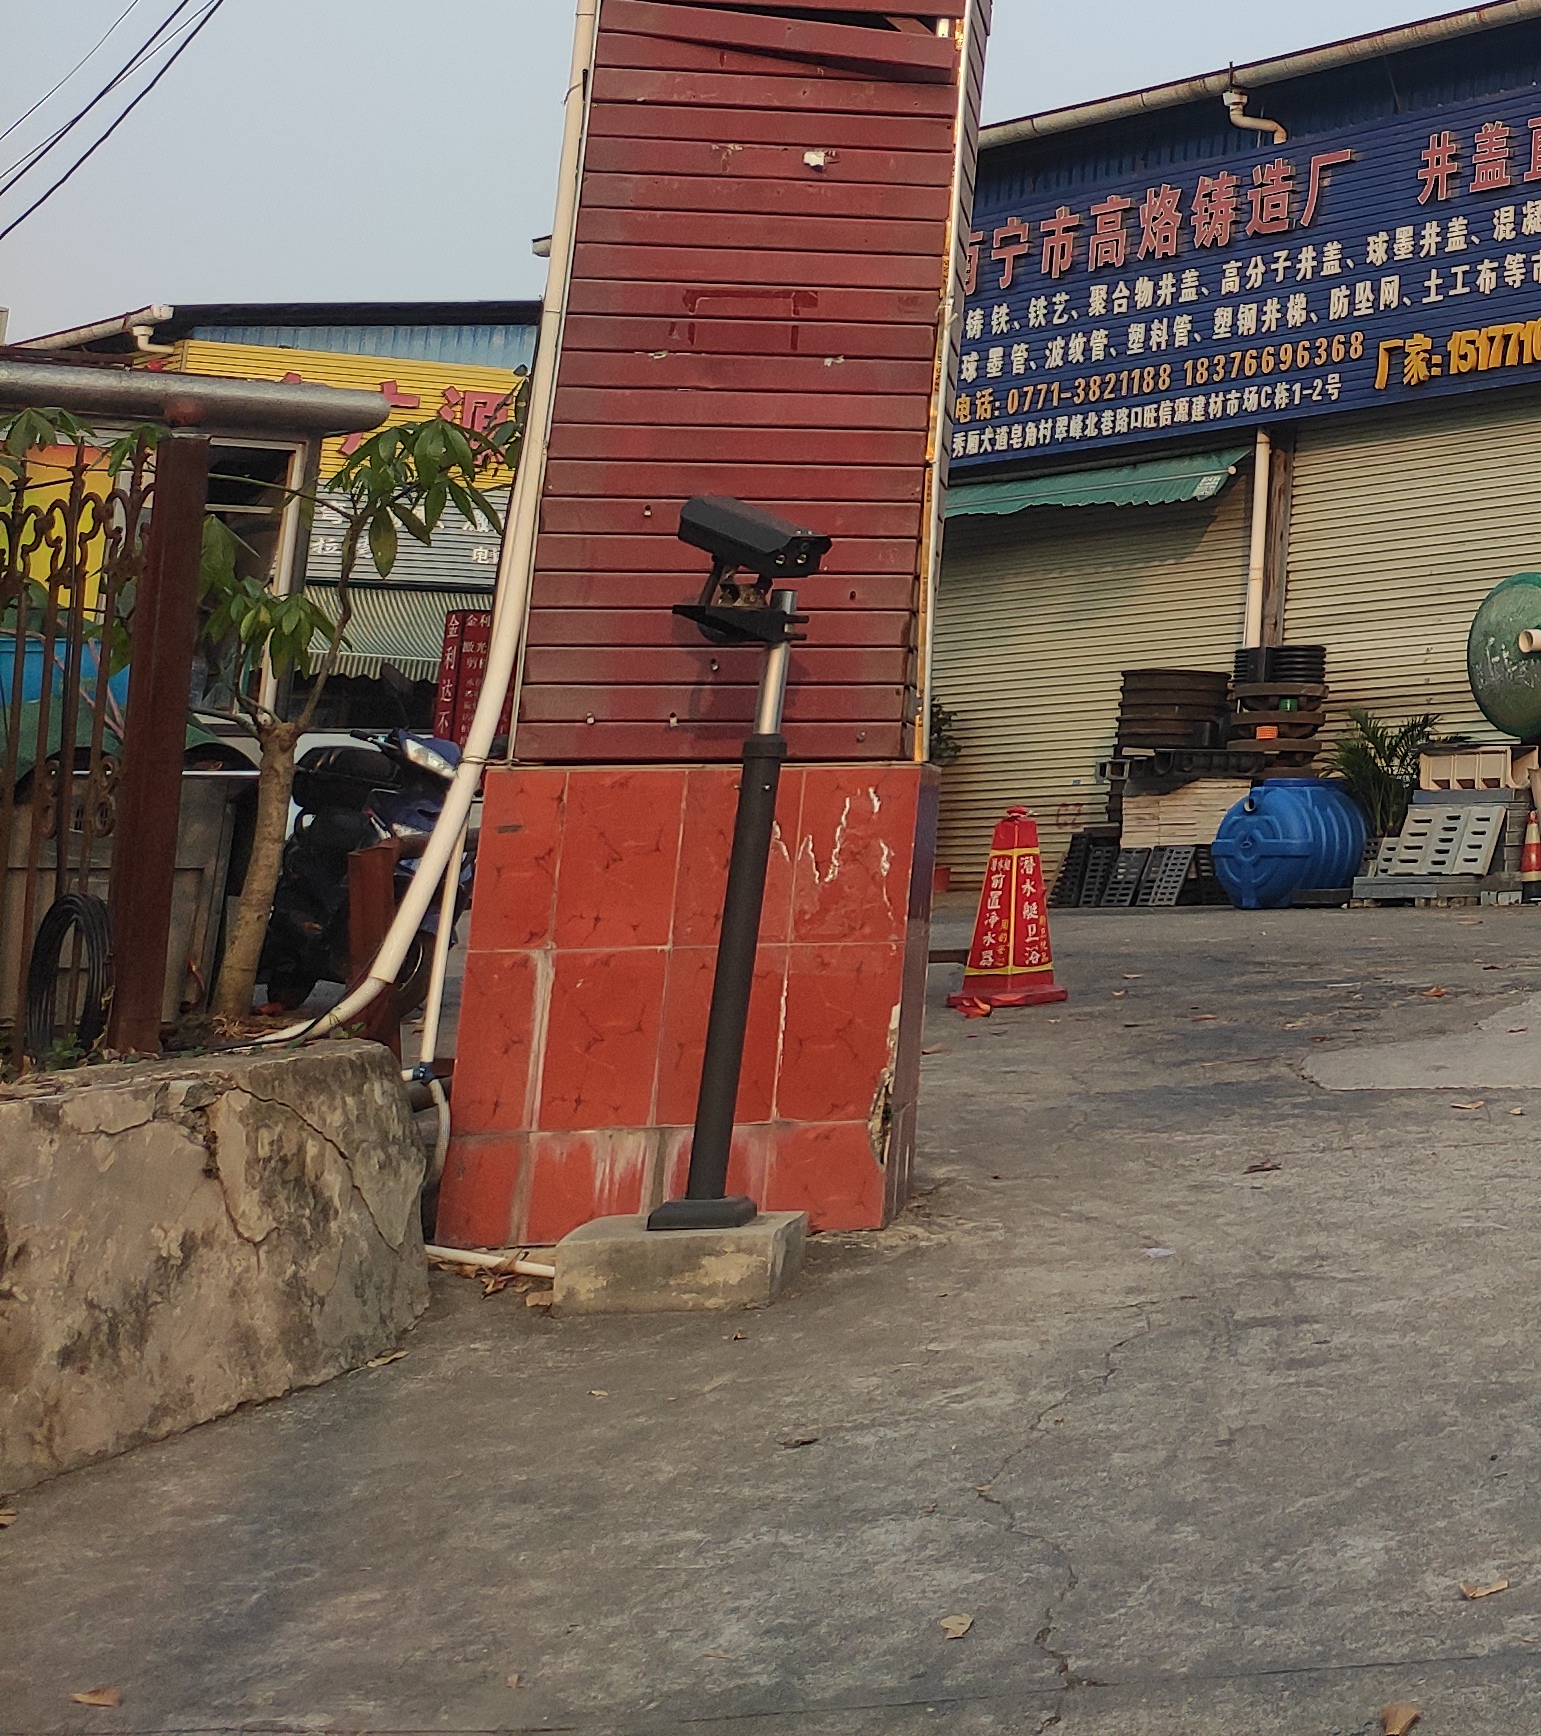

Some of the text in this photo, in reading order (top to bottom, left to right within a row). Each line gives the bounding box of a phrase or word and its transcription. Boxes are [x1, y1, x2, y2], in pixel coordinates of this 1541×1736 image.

[1183, 331, 1365, 387] 18376696368
[1019, 855, 1041, 965] 潜水艇卫浴
